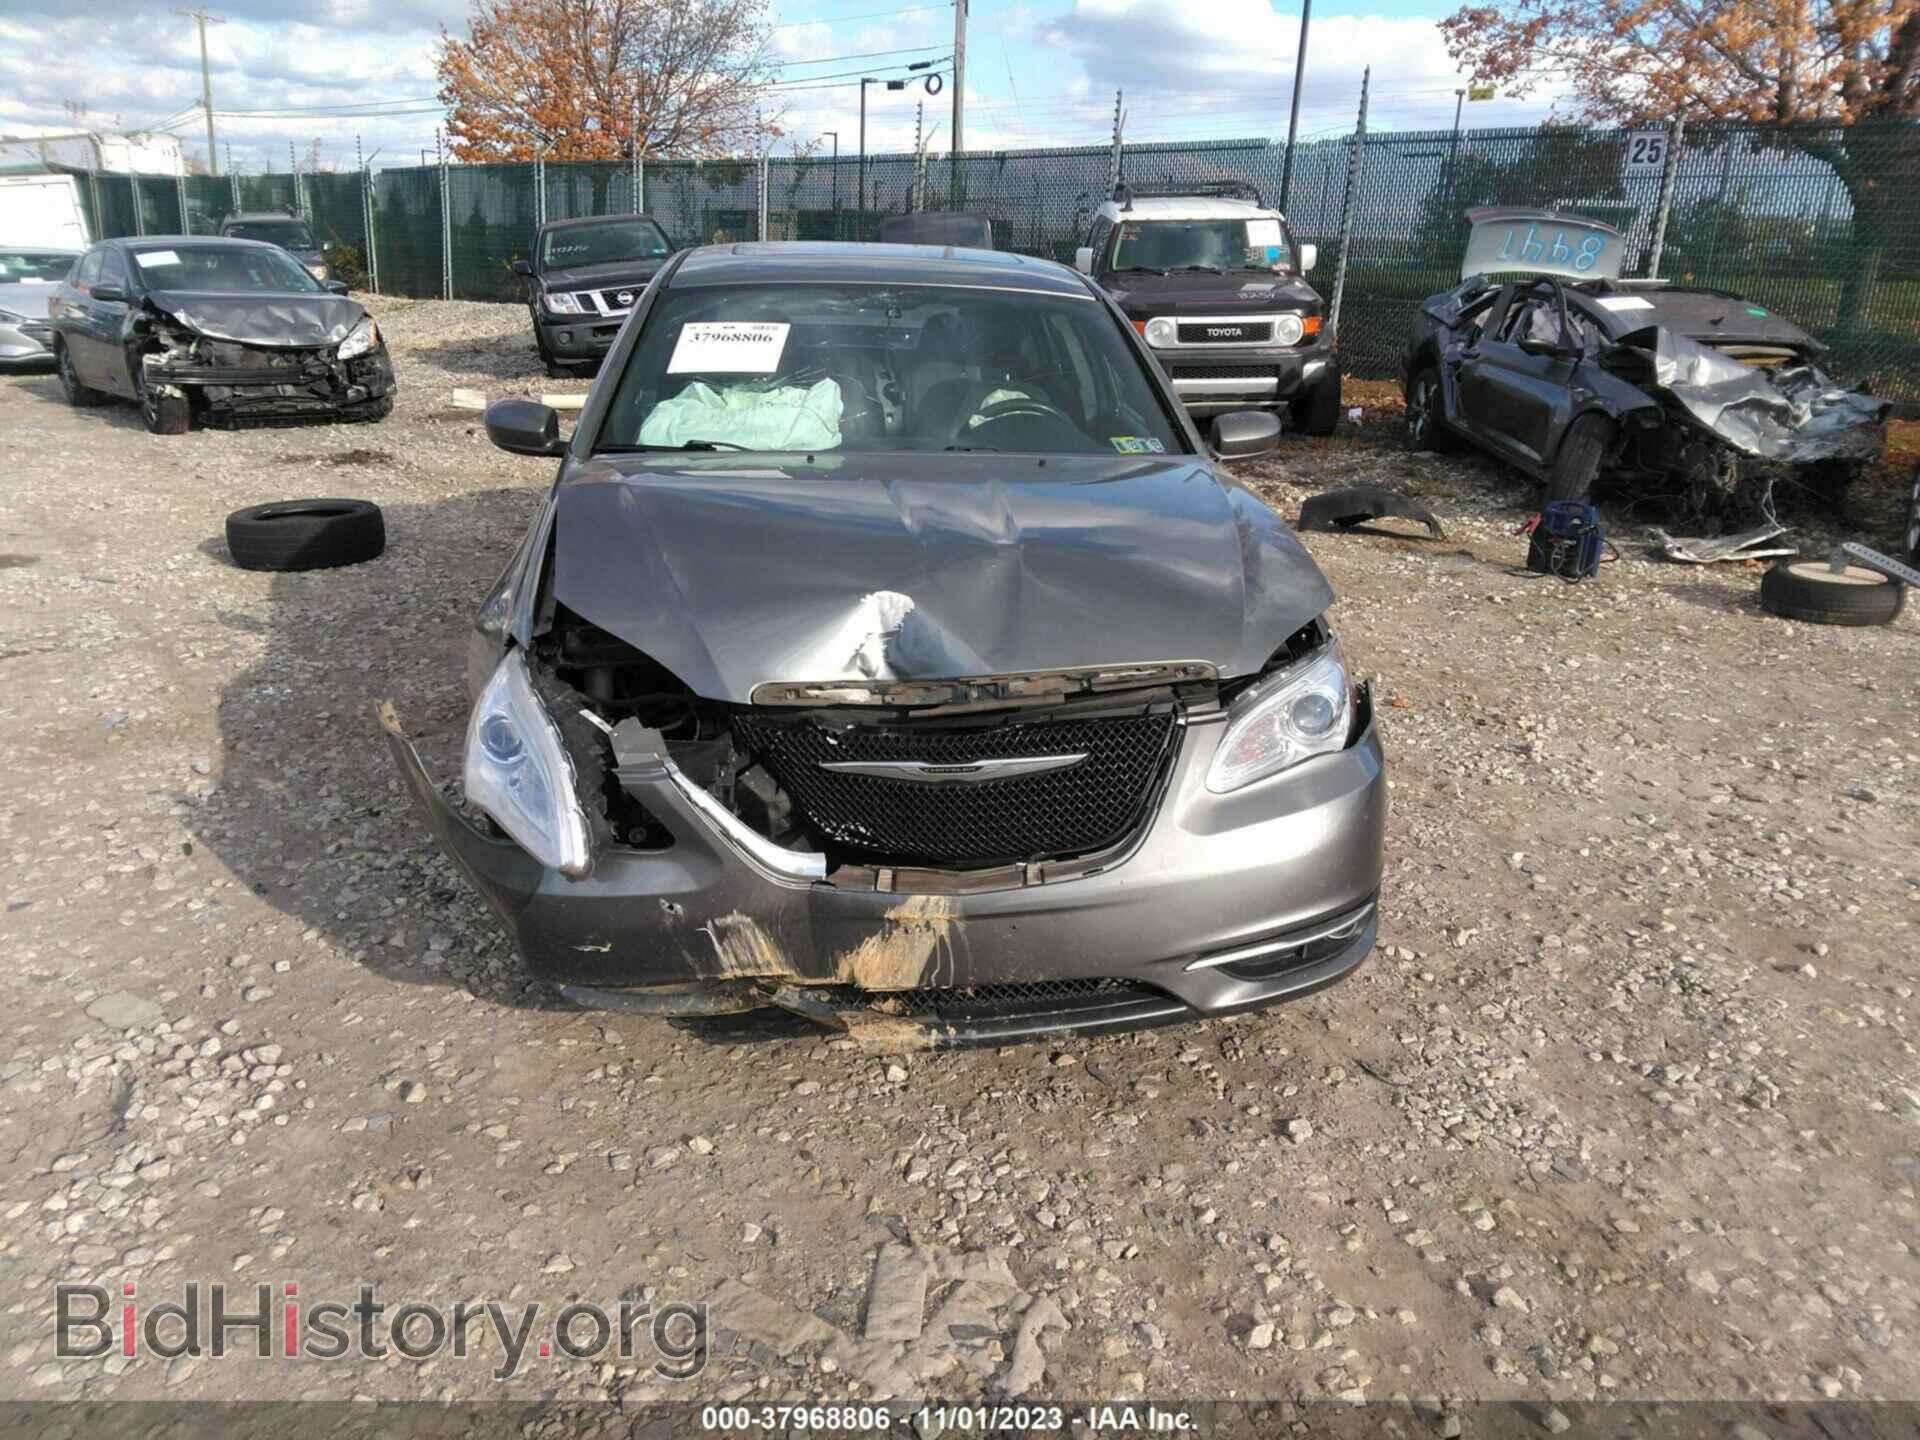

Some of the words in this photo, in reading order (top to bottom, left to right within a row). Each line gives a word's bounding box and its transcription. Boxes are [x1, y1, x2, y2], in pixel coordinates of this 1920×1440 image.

[1632, 137, 1663, 164] 25
[689, 332, 773, 343] 37968806
[1206, 327, 1242, 337] TOYOTA
